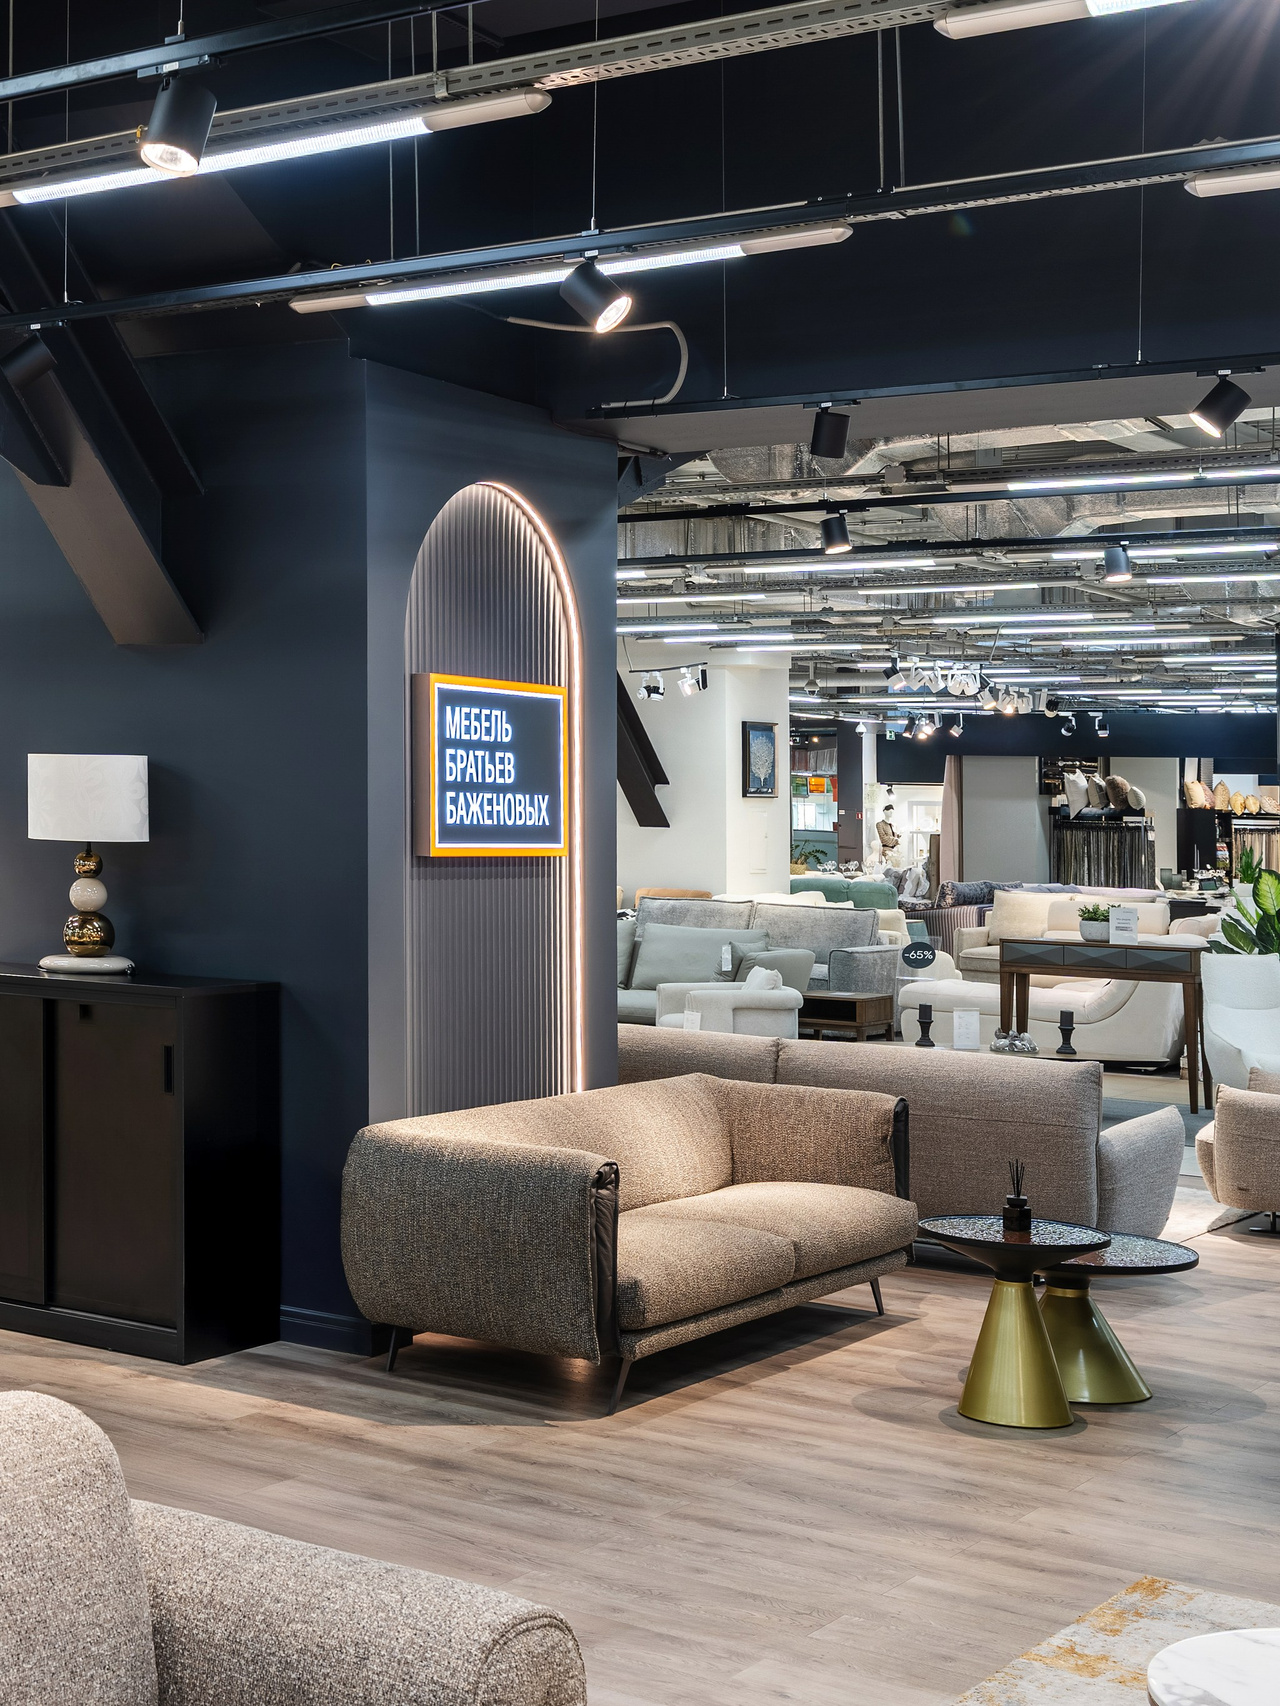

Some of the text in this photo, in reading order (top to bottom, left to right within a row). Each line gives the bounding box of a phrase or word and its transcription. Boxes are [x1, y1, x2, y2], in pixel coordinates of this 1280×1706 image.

[445, 705, 513, 743] МЕБЕЛЬ
[445, 748, 516, 784] БРАТЬЕВ
[445, 791, 551, 826] БАЖЕНОВЫХ
[904, 950, 934, 960] -65%
